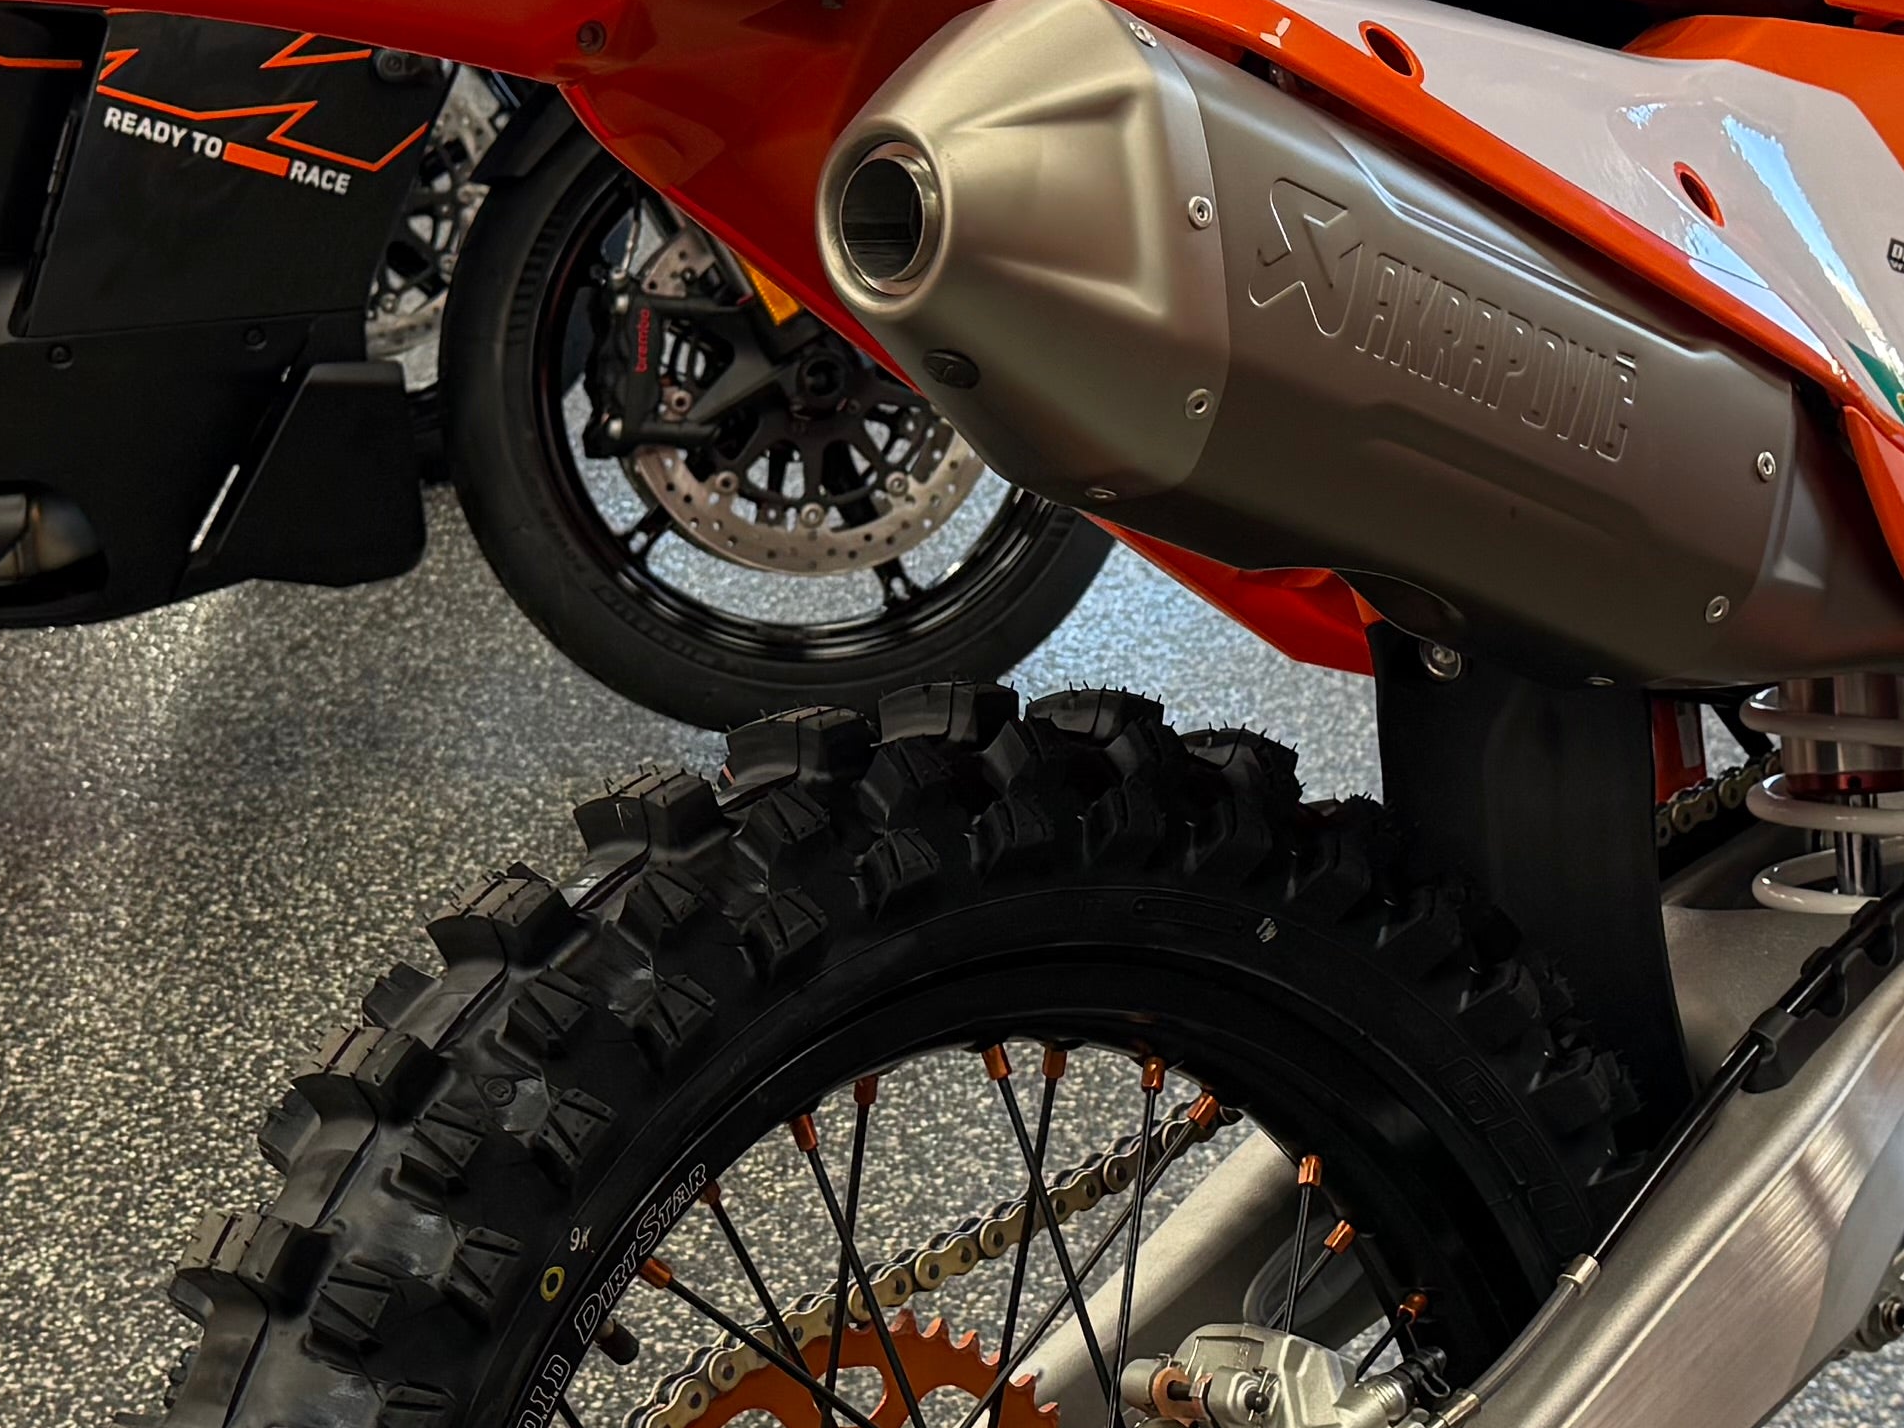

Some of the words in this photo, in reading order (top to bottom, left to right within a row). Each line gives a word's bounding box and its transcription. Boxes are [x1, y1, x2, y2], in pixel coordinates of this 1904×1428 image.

[104, 107, 187, 149] READY
[192, 132, 223, 159] TO
[289, 160, 351, 195] RACE
[634, 307, 652, 373] brembo
